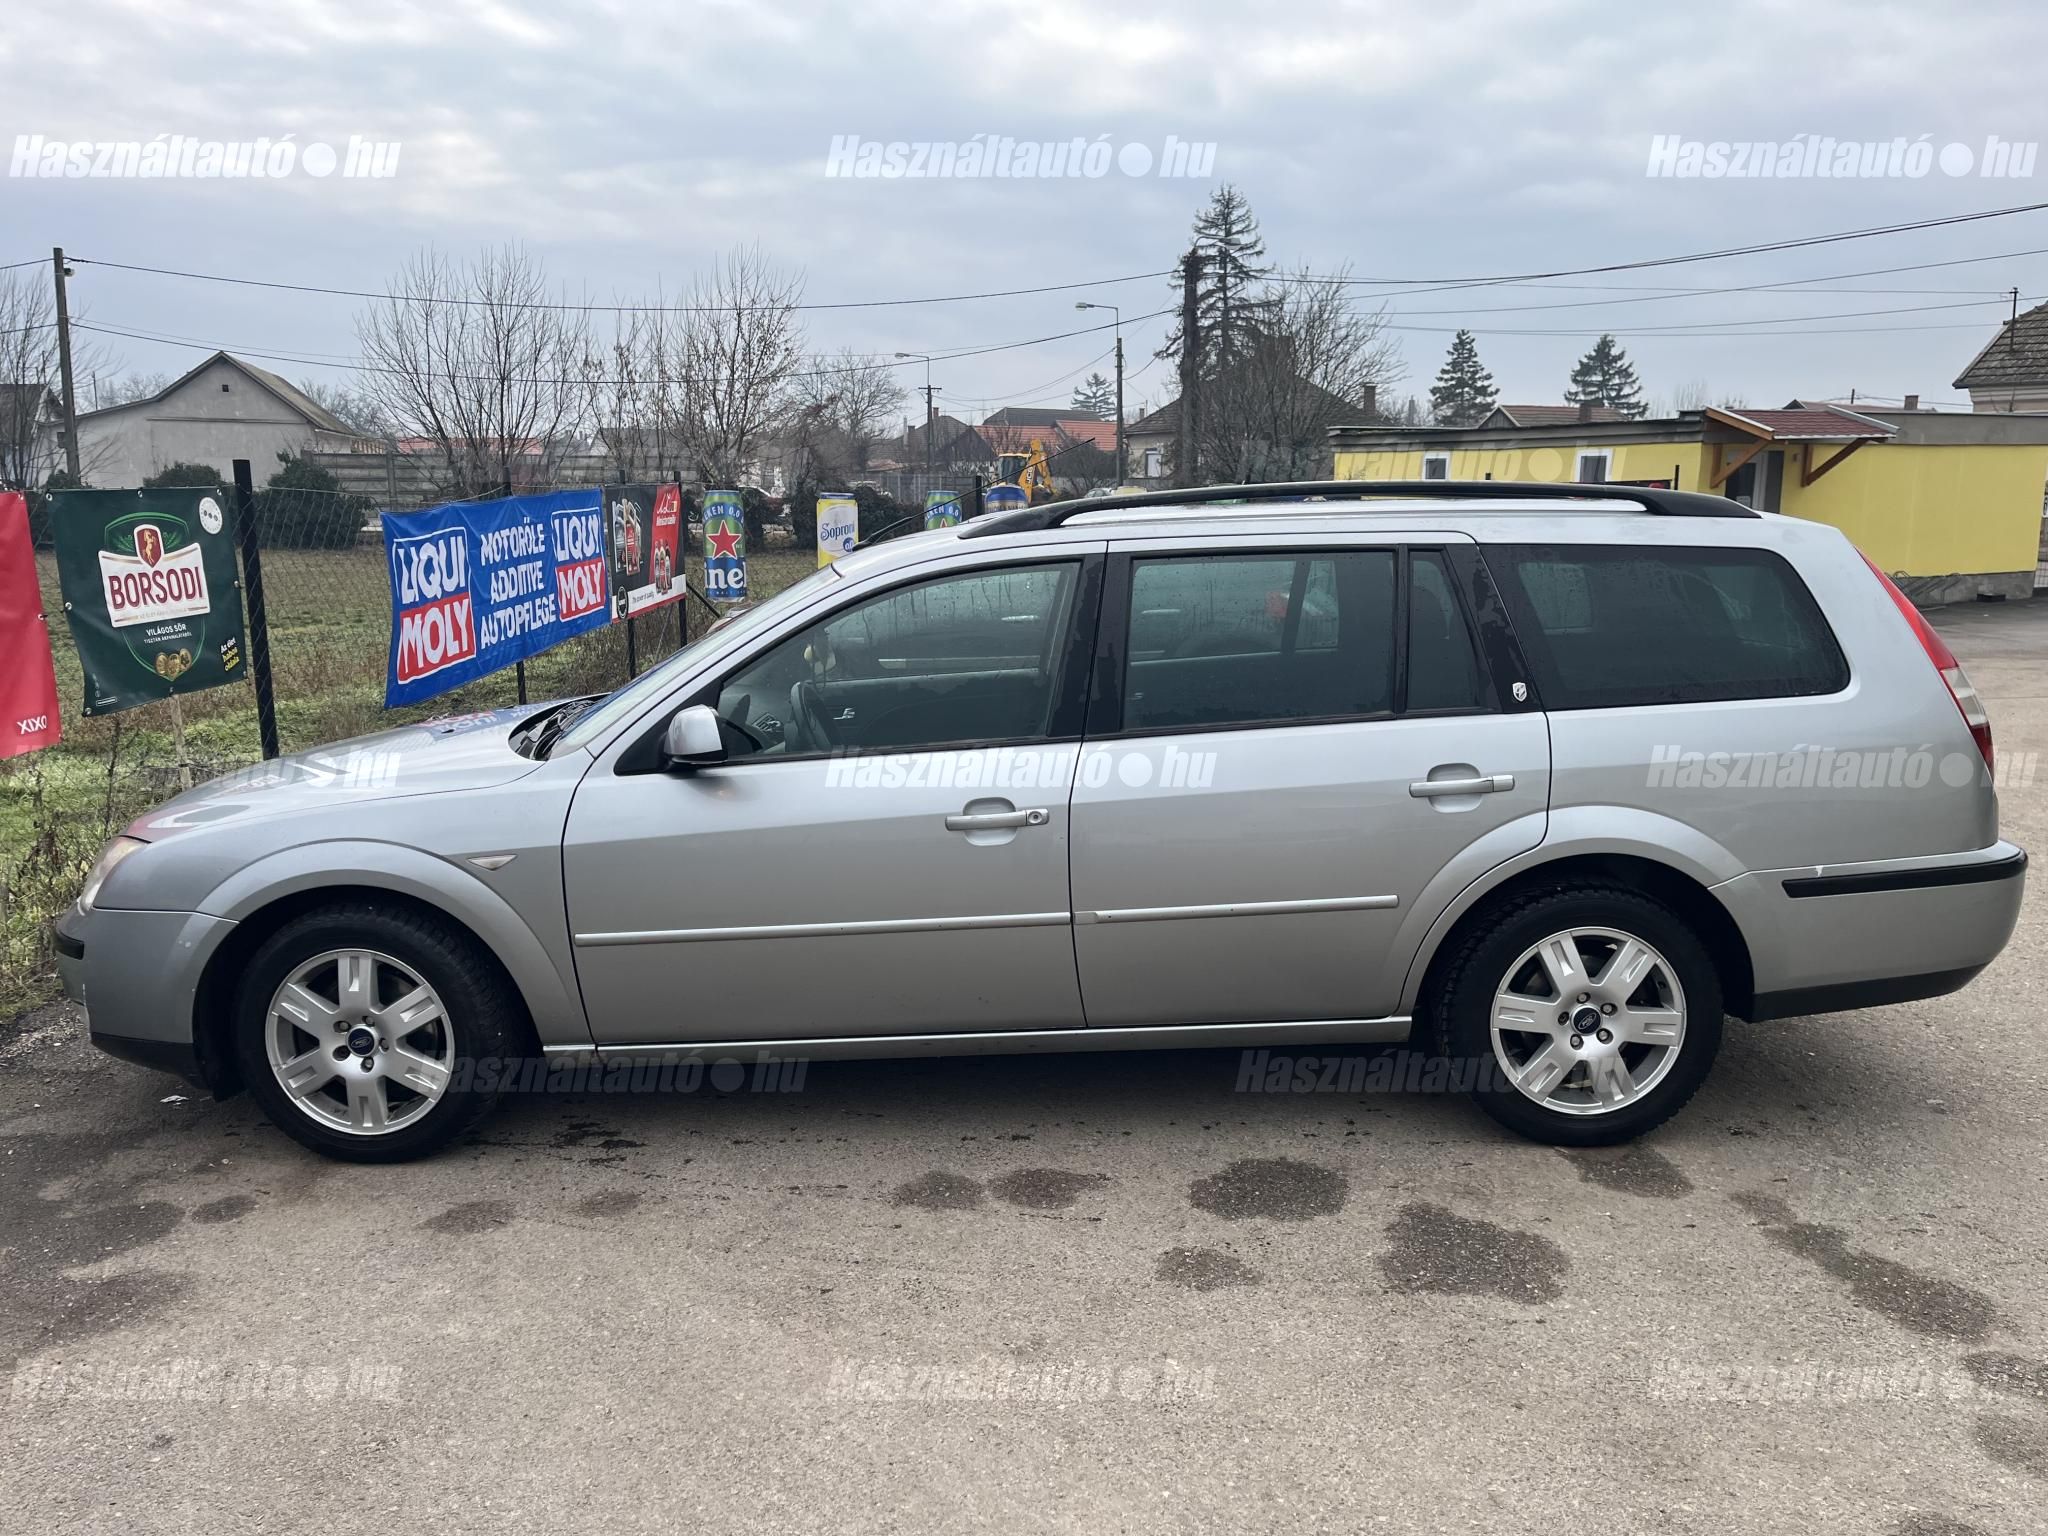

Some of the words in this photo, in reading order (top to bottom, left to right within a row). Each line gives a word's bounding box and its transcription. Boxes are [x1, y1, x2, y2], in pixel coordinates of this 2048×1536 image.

[480, 517, 546, 566] MOTORÖLE
[554, 514, 600, 562] LIQUI
[108, 566, 203, 610] BORSODI
[397, 536, 466, 604] LIQUI
[490, 560, 545, 605] ADDITIVE
[558, 561, 603, 614] MOLY
[399, 598, 470, 674] MOLY
[480, 593, 557, 650] AUTOPFLEGE
[16, 715, 47, 735] XIXO
